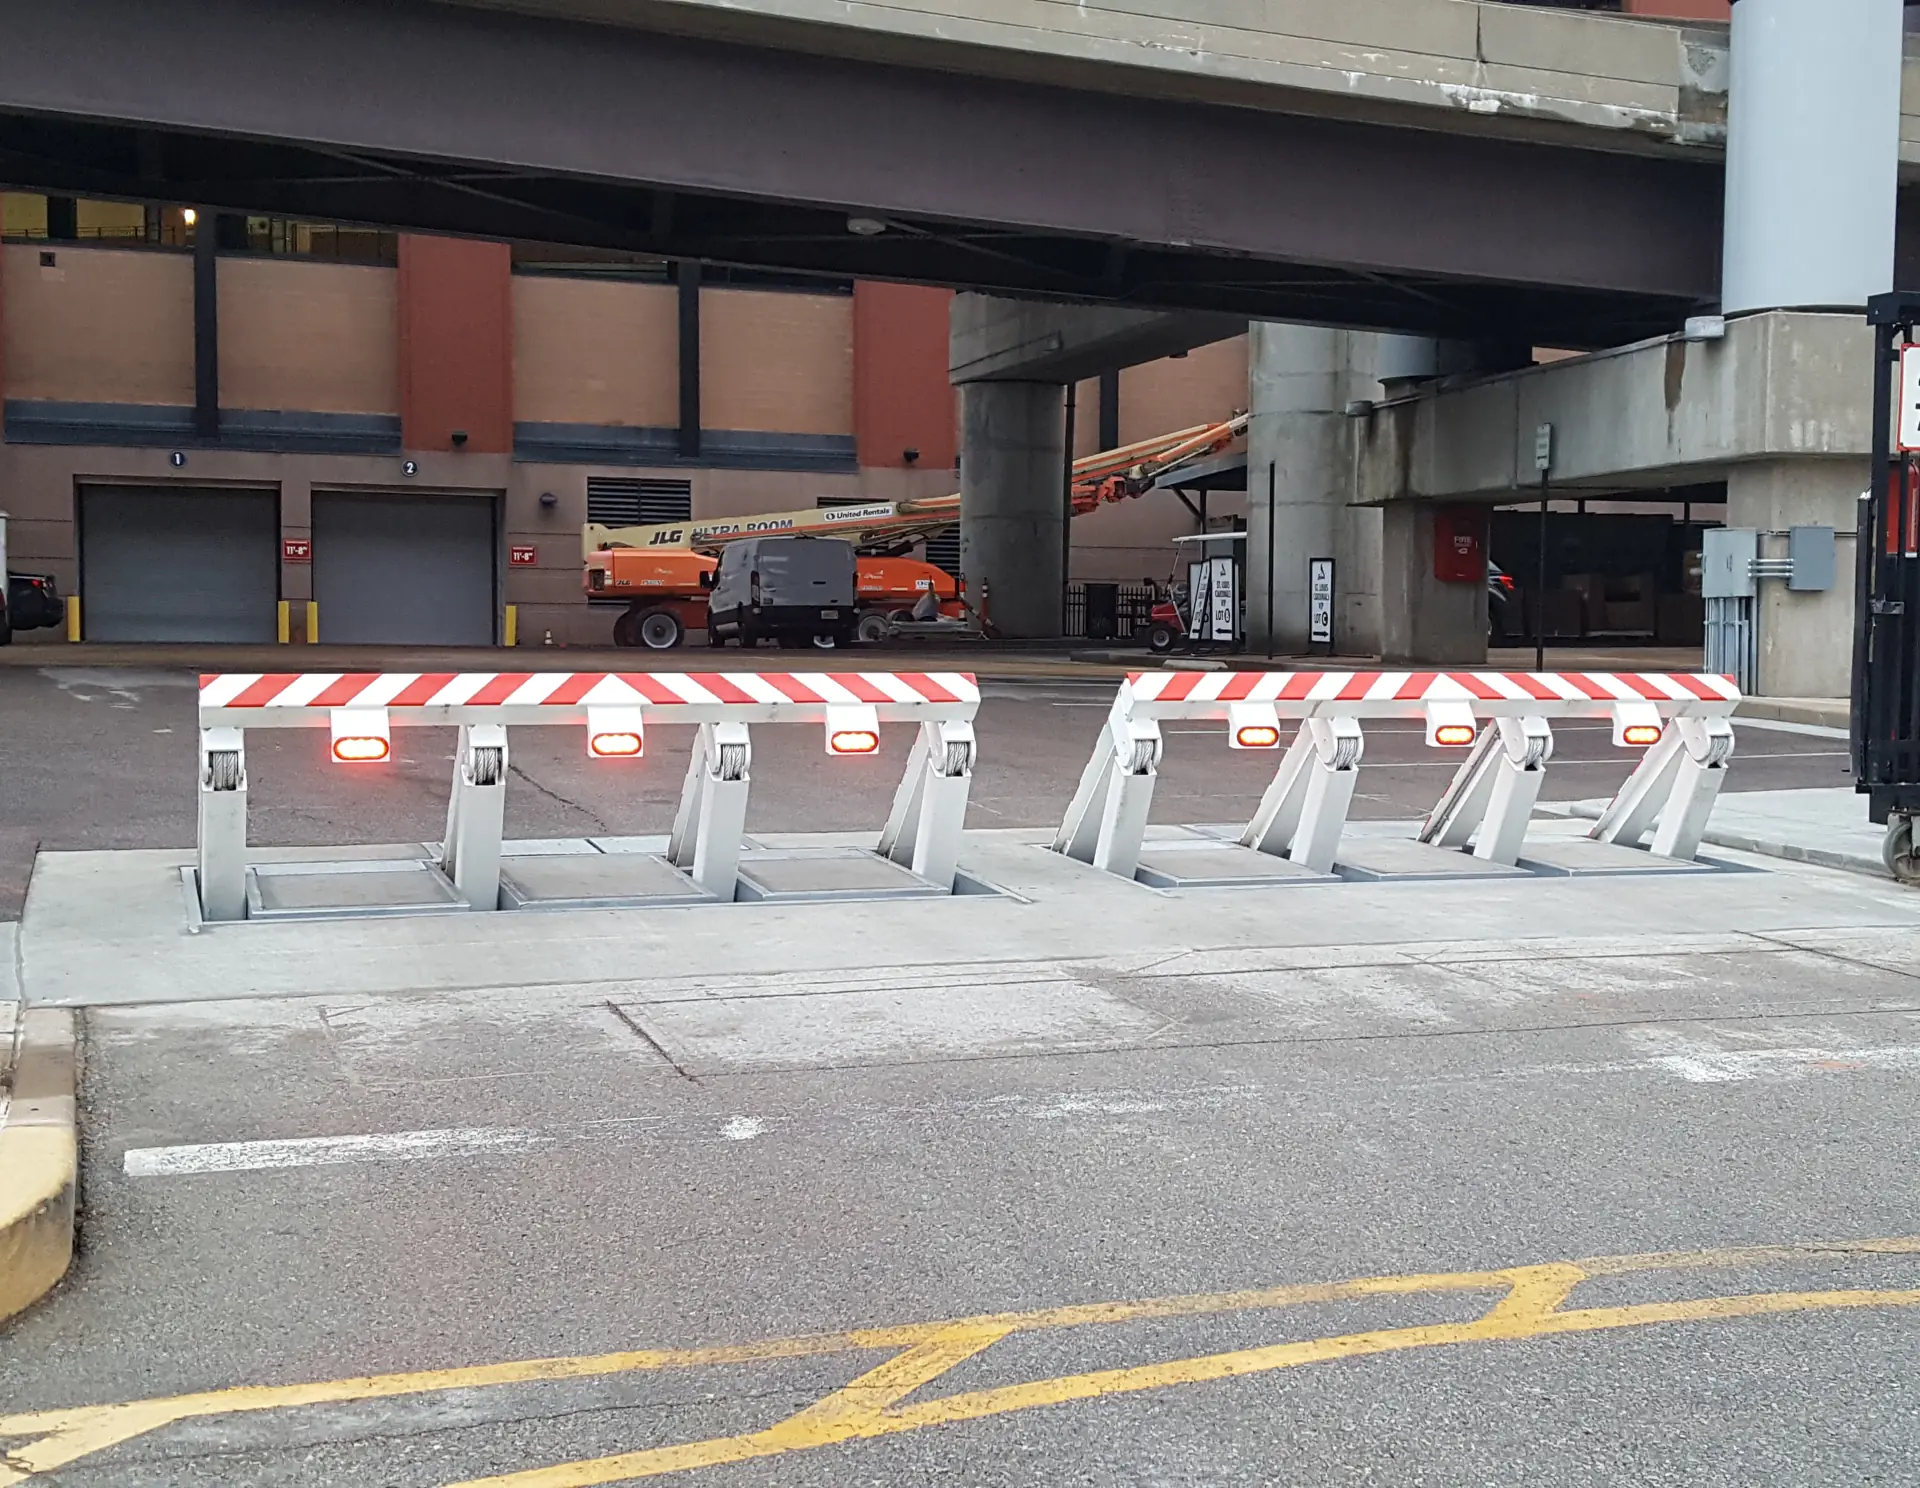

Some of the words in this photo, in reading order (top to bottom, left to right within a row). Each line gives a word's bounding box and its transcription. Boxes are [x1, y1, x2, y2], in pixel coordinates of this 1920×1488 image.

[174, 453, 181, 465] 1
[406, 462, 414, 474] 2
[836, 509, 862, 520] United
[862, 507, 891, 517] Rentals
[649, 530, 683, 545] JLG
[745, 519, 794, 533] BOOM
[1216, 610, 1224, 620] LOT
